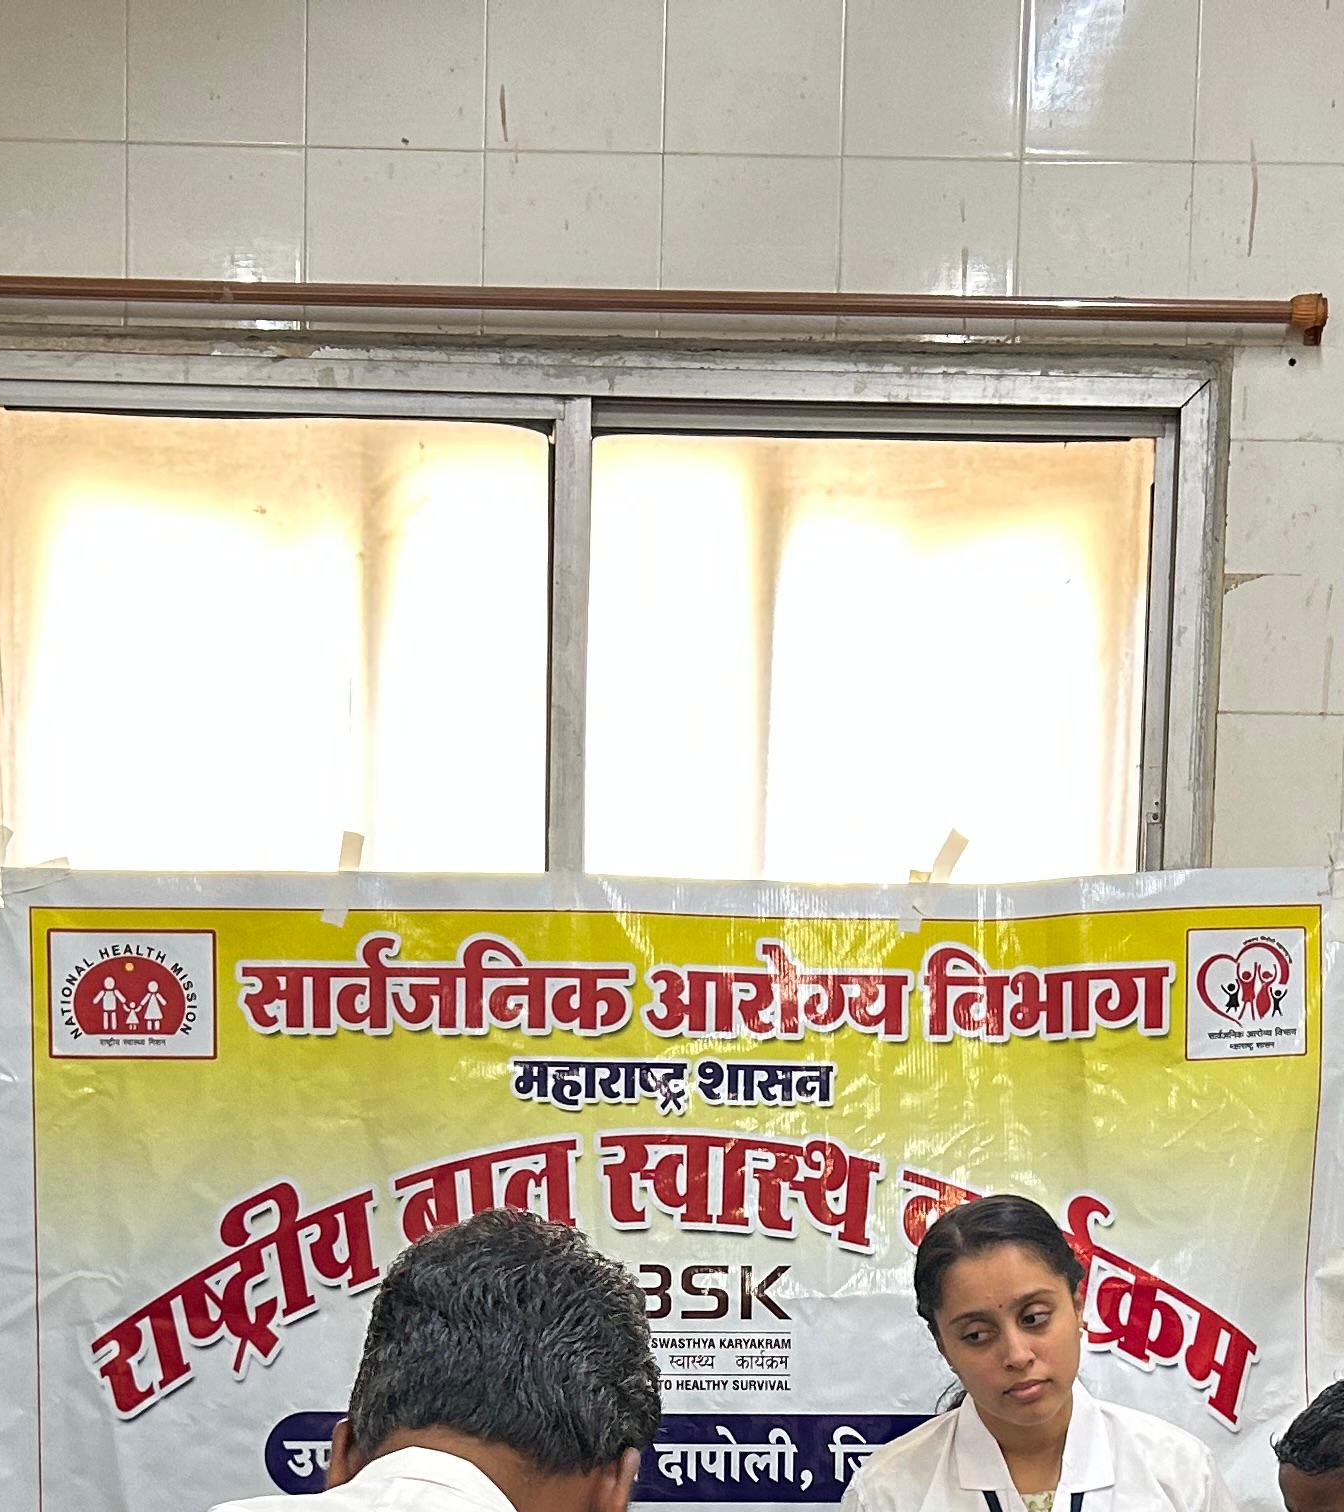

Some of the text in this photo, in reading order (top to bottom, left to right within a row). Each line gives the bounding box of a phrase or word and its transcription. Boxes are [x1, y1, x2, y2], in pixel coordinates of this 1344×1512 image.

[61, 944, 197, 1040] NATIONAL HEALTH MISSION
[241, 936, 1170, 1036] सार्वजनिक आरोग्य विभाग
[513, 1060, 834, 1111] महाराष्ट्र शासन
[91, 1182, 380, 1412] राष्ट्रीय
[651, 1338, 792, 1350] SWASTHYA KARYAKRAM
[669, 1350, 790, 1370] स्वास्थ्य कार्यक्रम
[658, 1380, 791, 1391] TO HEALTHY SURVIVAL
[653, 1426, 814, 1491] दापोली,
